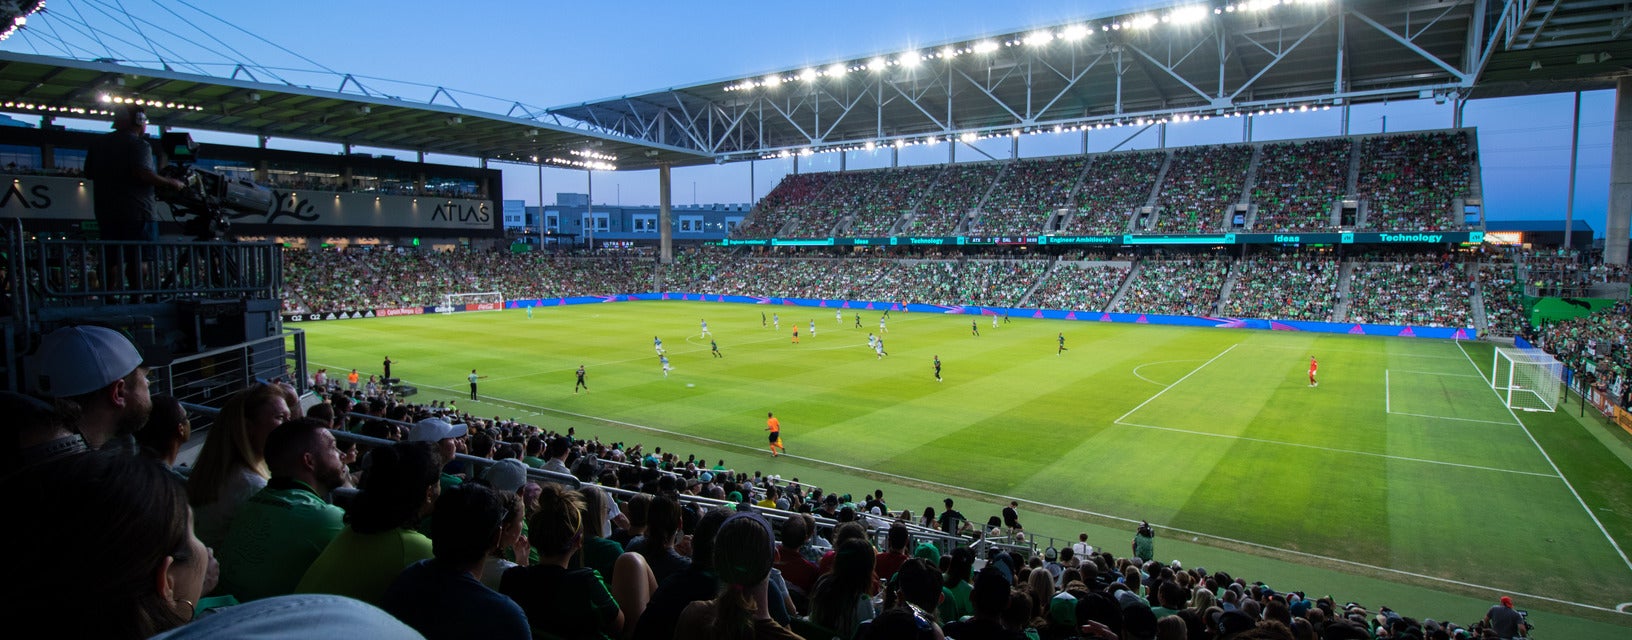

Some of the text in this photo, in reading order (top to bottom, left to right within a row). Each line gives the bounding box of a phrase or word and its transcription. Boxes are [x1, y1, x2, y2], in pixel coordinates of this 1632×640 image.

[432, 204, 490, 223] ATLAS
[1274, 235, 1299, 243] Ideas
[1380, 234, 1442, 243] Technology
